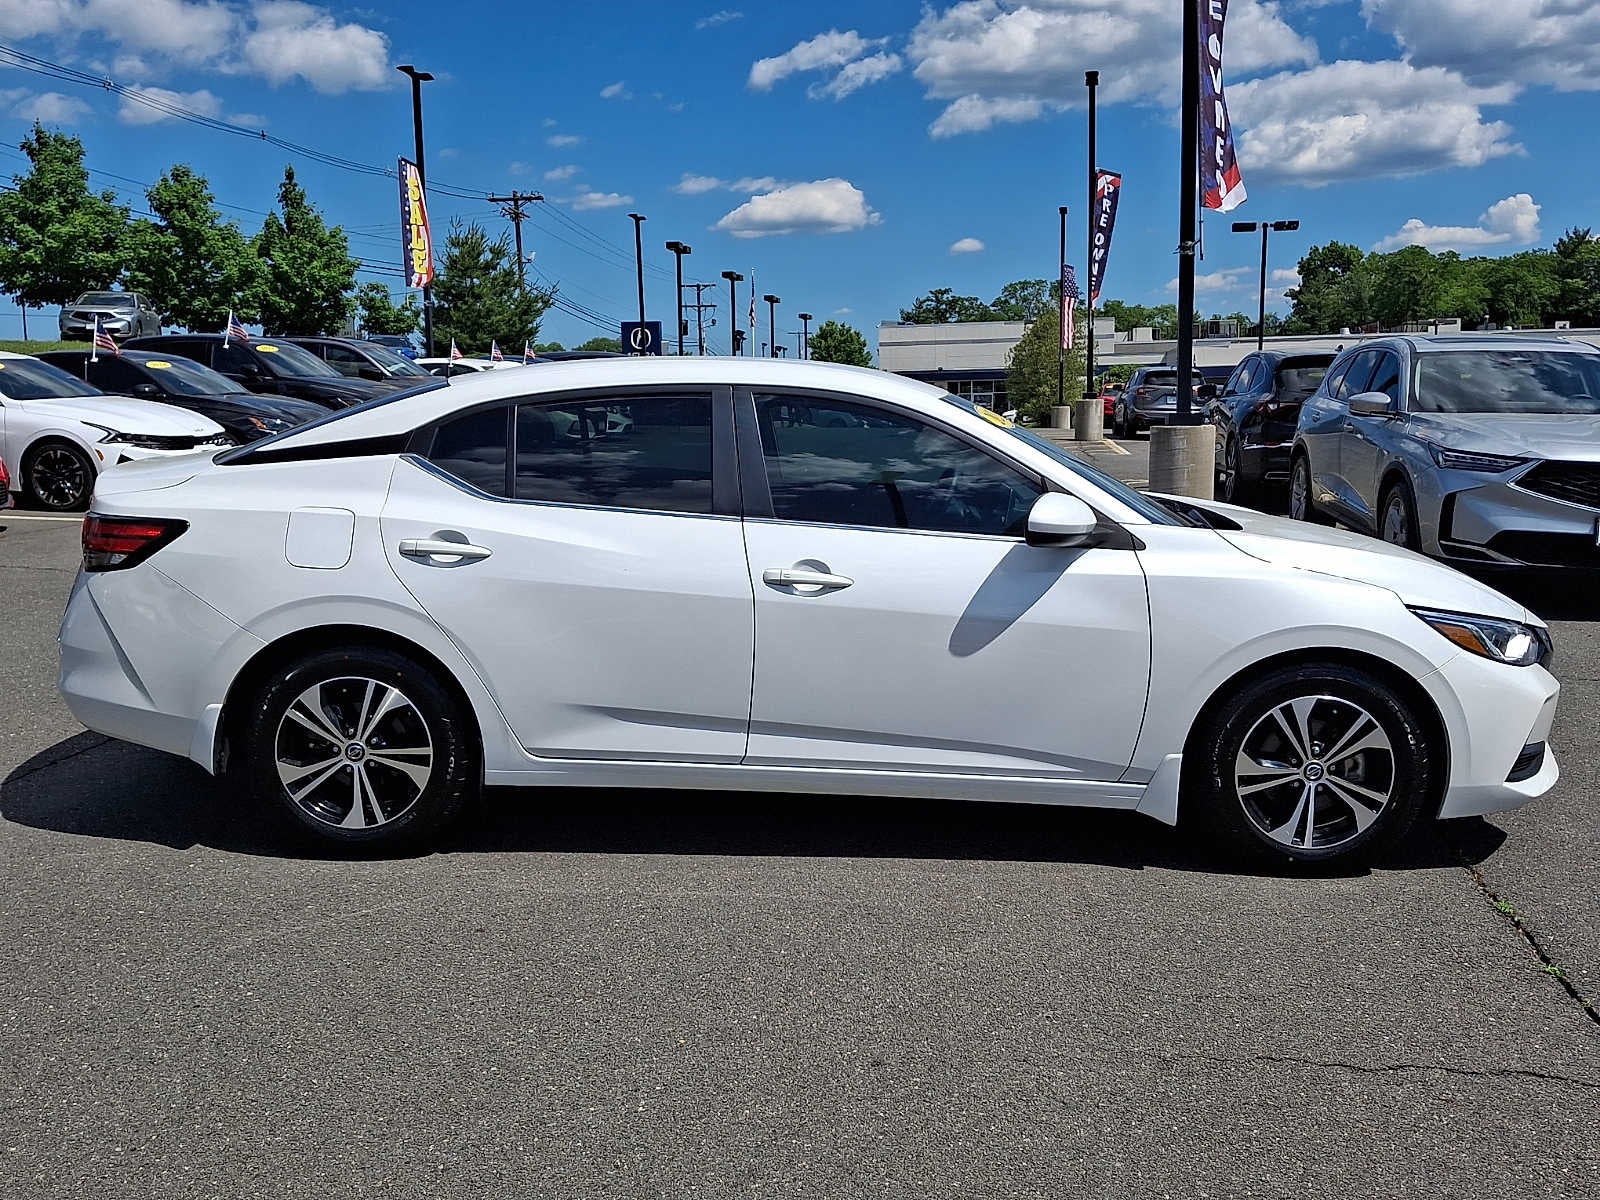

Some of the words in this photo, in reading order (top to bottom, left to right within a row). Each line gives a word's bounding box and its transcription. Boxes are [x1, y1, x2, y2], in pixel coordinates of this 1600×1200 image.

[408, 177, 428, 274] SALE
[1099, 184, 1115, 228] PRE
[1091, 232, 1105, 297] OWNE
